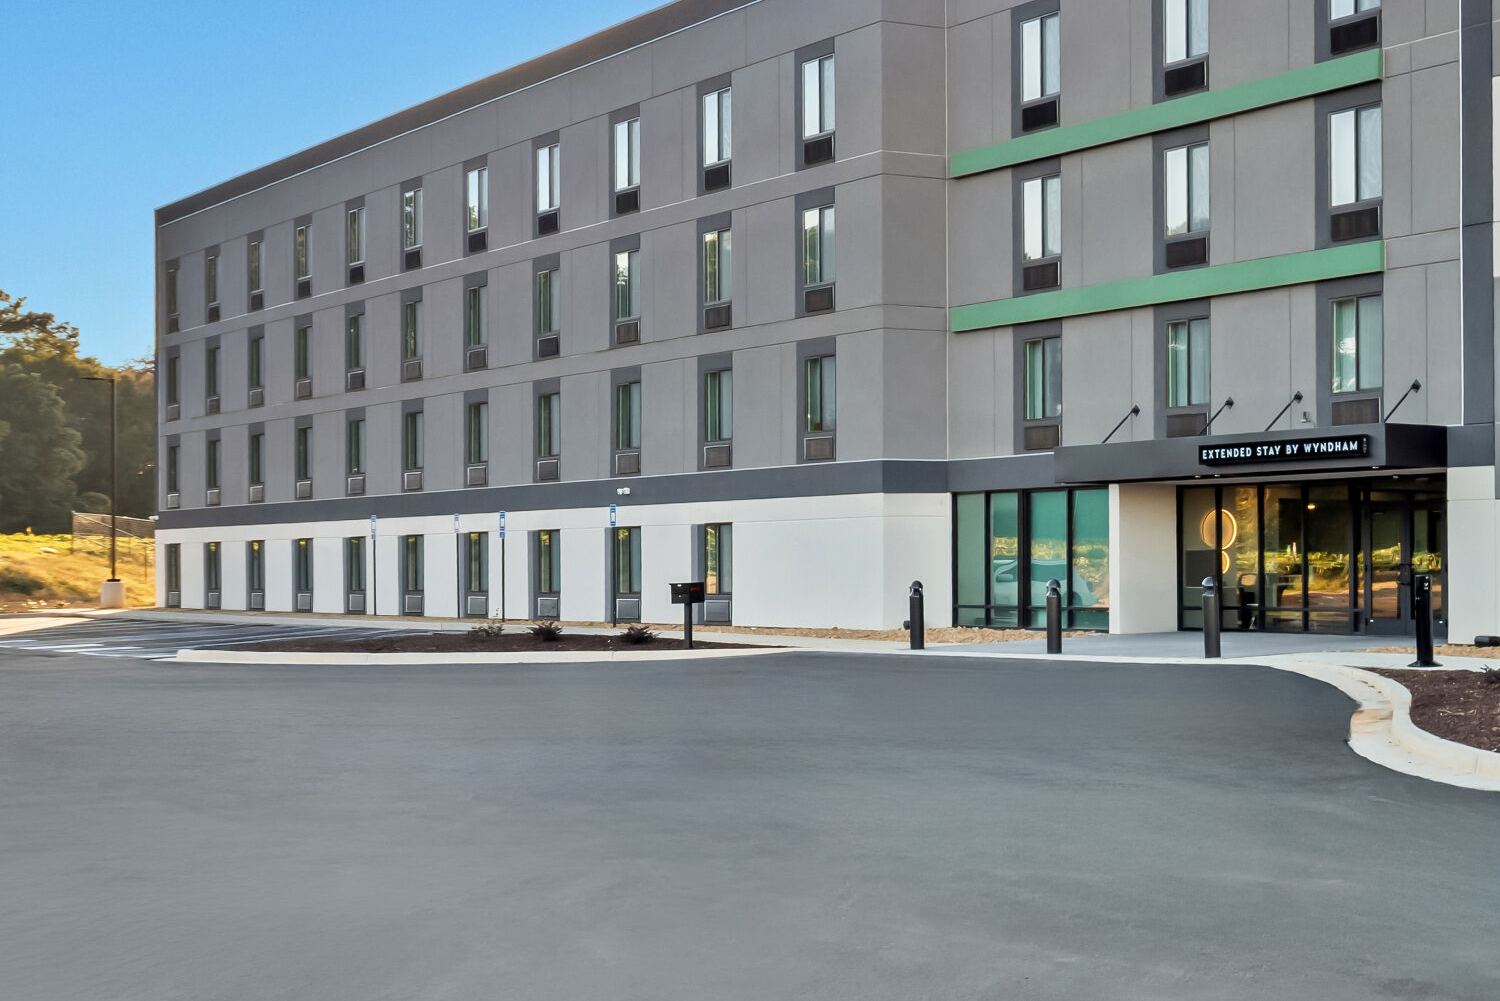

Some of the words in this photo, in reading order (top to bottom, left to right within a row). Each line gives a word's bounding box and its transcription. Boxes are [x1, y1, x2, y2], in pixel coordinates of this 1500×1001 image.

[1202, 447, 1252, 460] EXTENDED
[1256, 445, 1281, 457] STAY
[1285, 444, 1299, 455] BY
[1304, 440, 1358, 453] WYNDHAM
